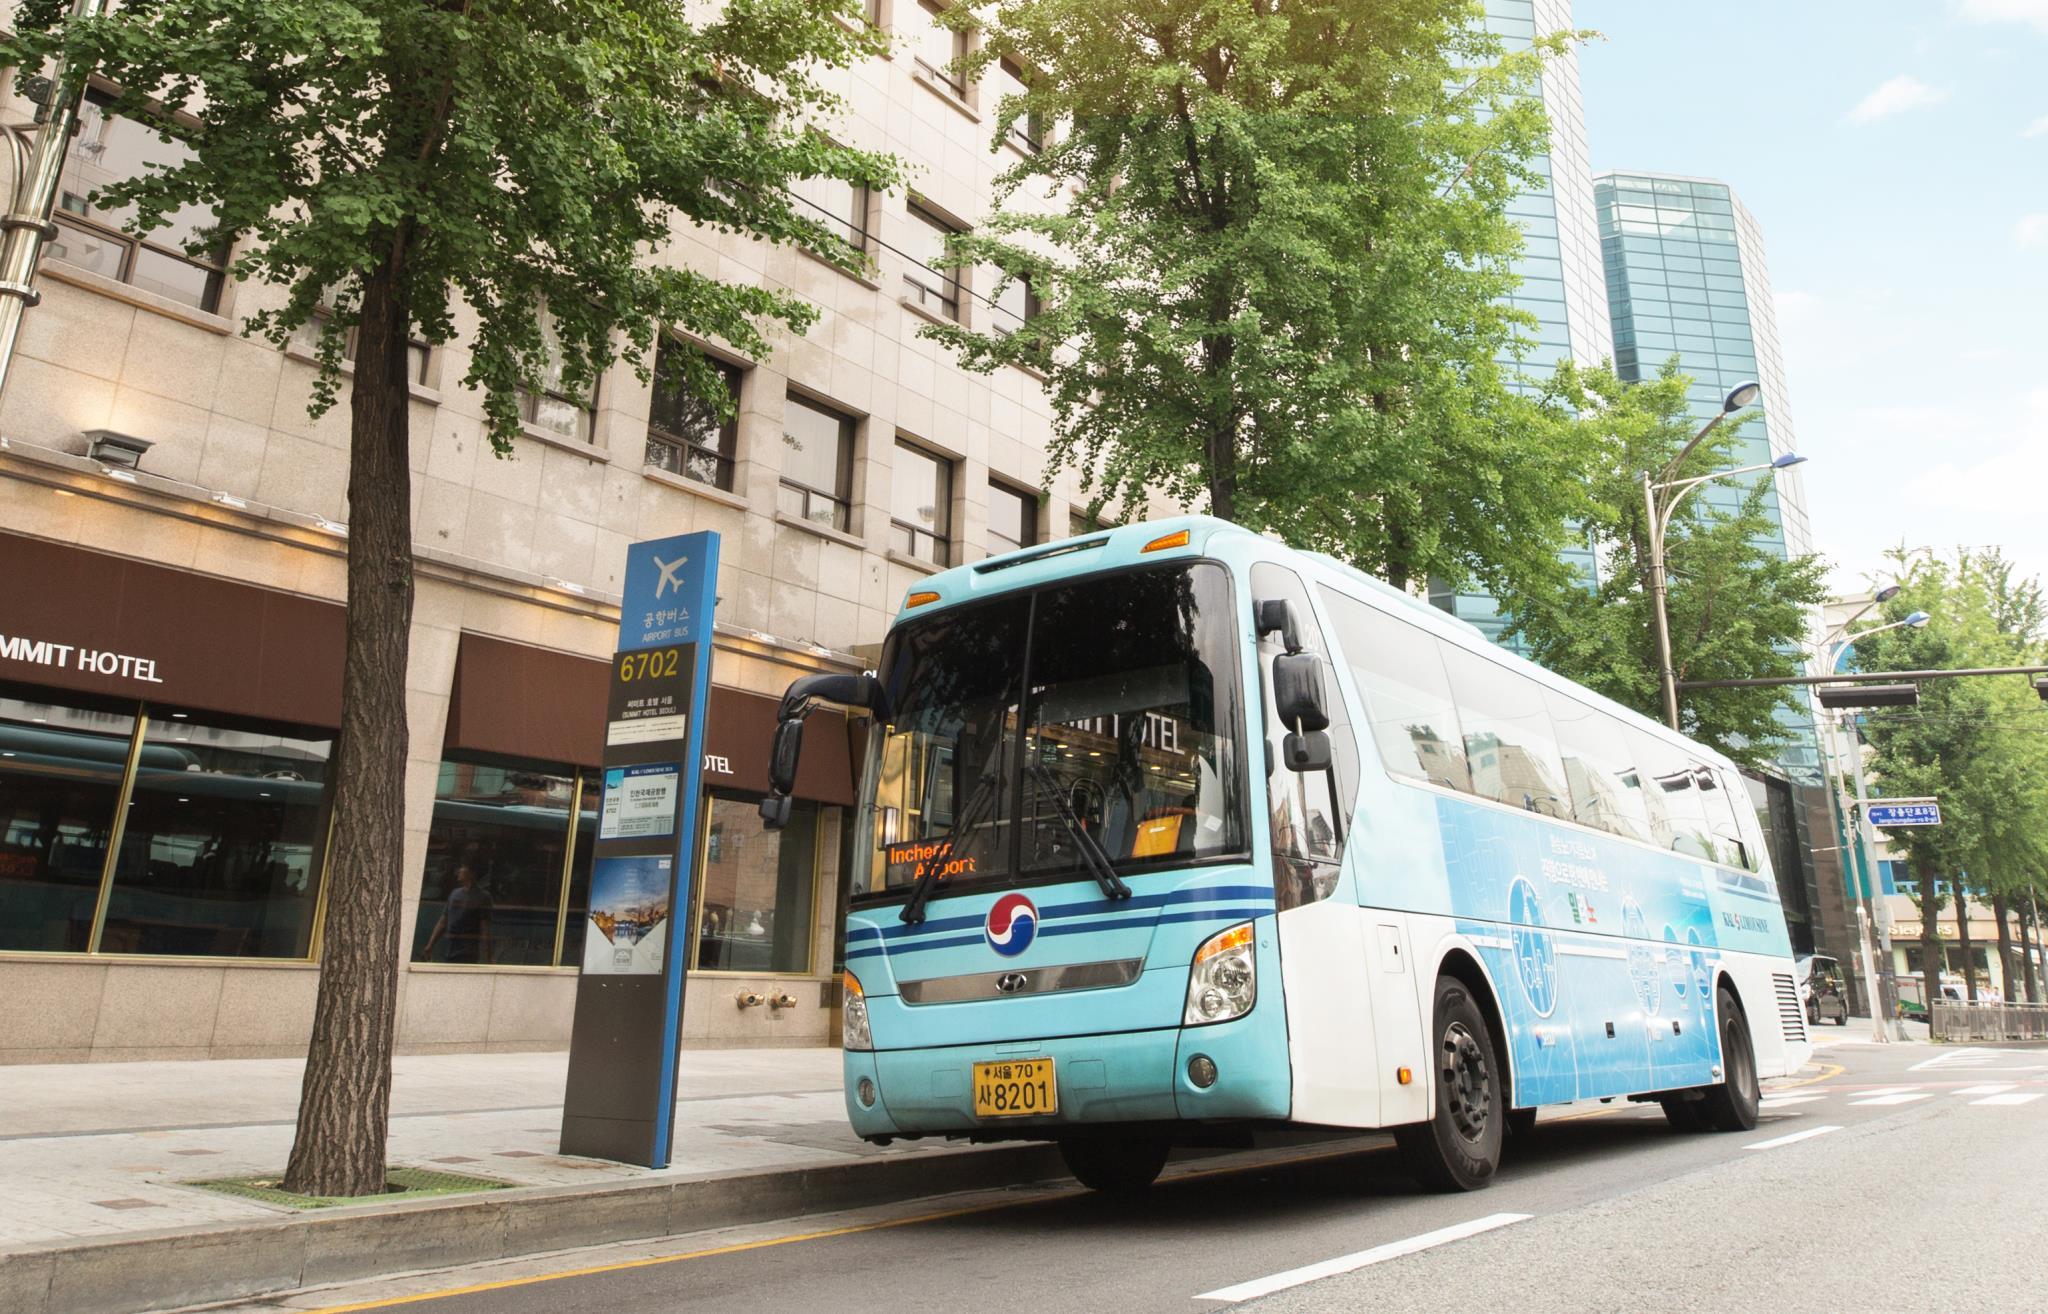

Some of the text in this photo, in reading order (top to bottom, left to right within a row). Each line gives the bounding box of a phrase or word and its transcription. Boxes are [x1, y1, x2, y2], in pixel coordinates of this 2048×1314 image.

[643, 607, 690, 628] 공항버스
[642, 626, 688, 642] AIRPORT BUS
[77, 648, 163, 683] HOTEL
[620, 648, 678, 682] 6702
[642, 707, 657, 716] HOTEL
[993, 1063, 1033, 1080] 서울 70
